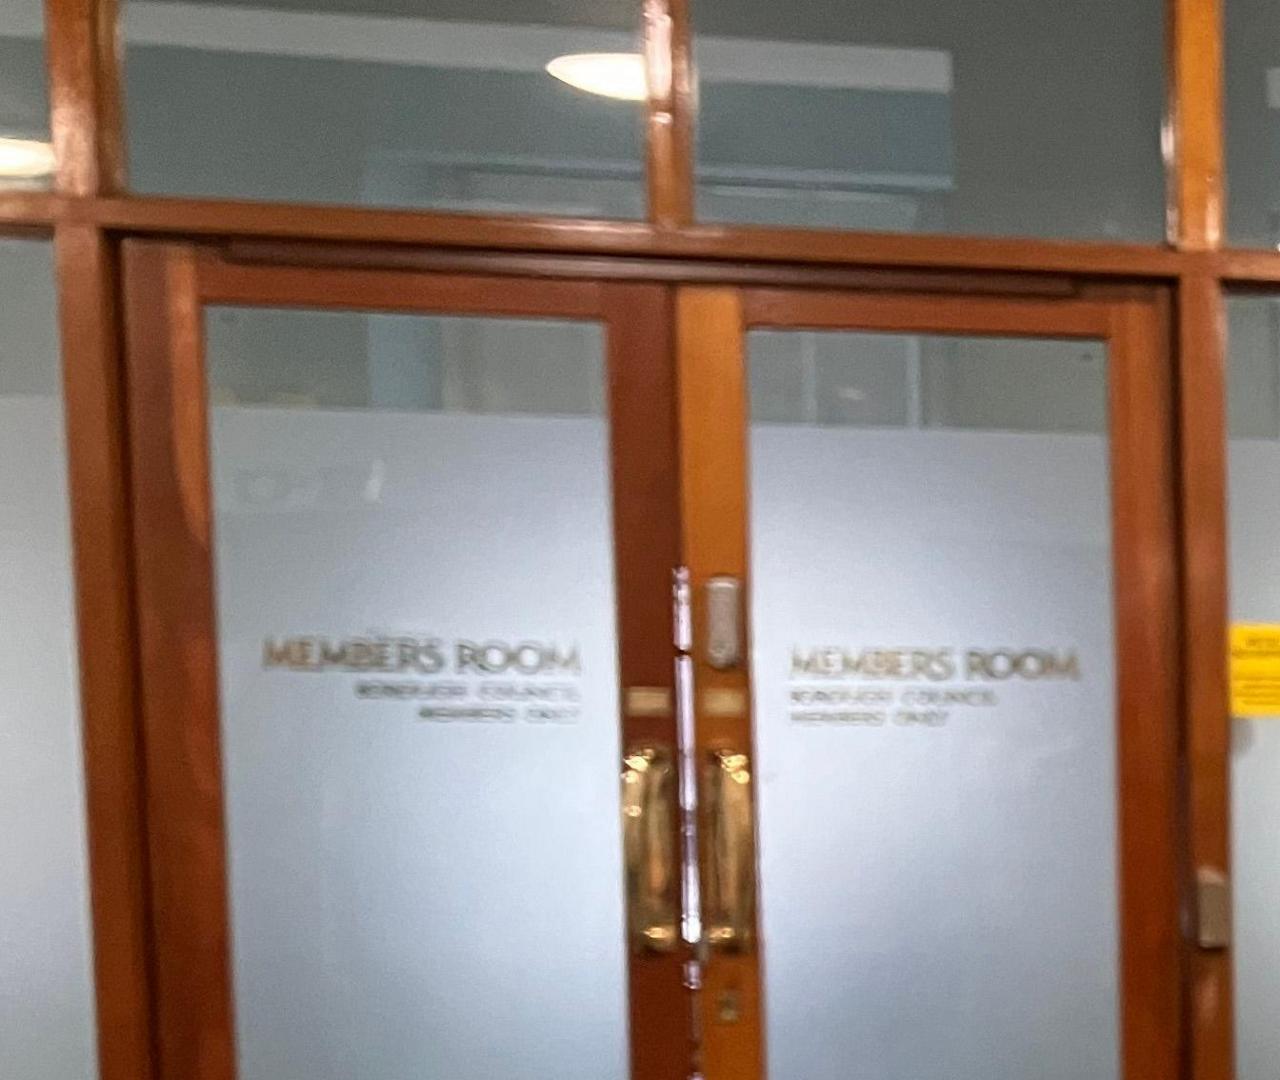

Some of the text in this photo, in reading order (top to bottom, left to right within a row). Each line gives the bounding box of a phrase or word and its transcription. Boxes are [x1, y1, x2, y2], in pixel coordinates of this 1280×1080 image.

[262, 638, 581, 675] MEMBERS ROOM
[791, 647, 1081, 681] MEMBERS ROOM
